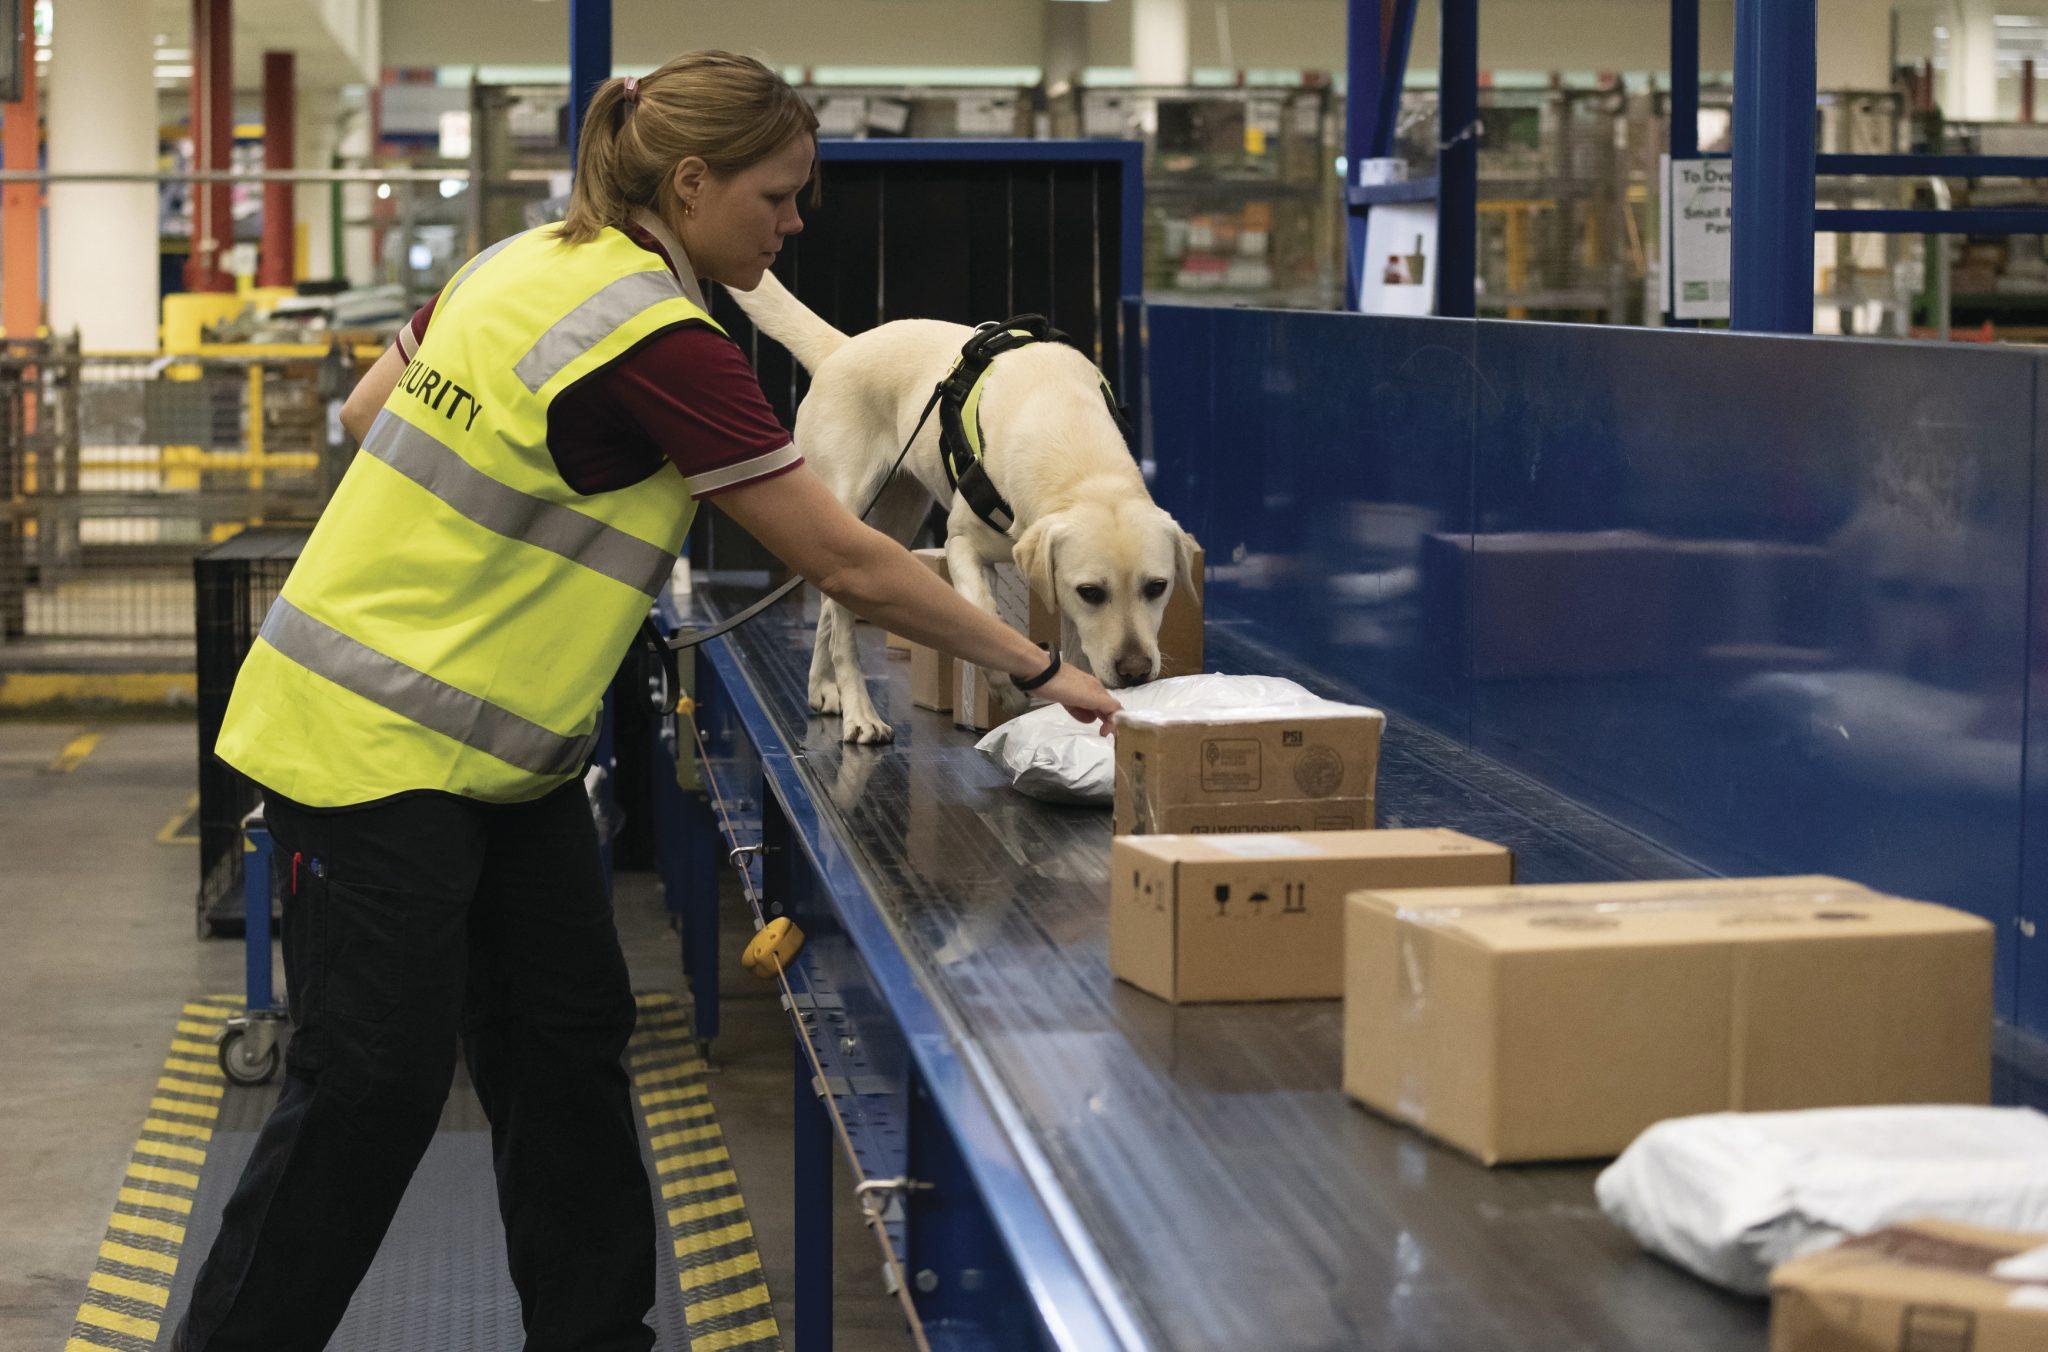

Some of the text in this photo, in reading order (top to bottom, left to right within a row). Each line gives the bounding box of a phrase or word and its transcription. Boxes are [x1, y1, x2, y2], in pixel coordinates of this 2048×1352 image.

[1682, 169, 1701, 183] To
[1683, 207, 1722, 220] Small
[1282, 731, 1303, 744] PSI
